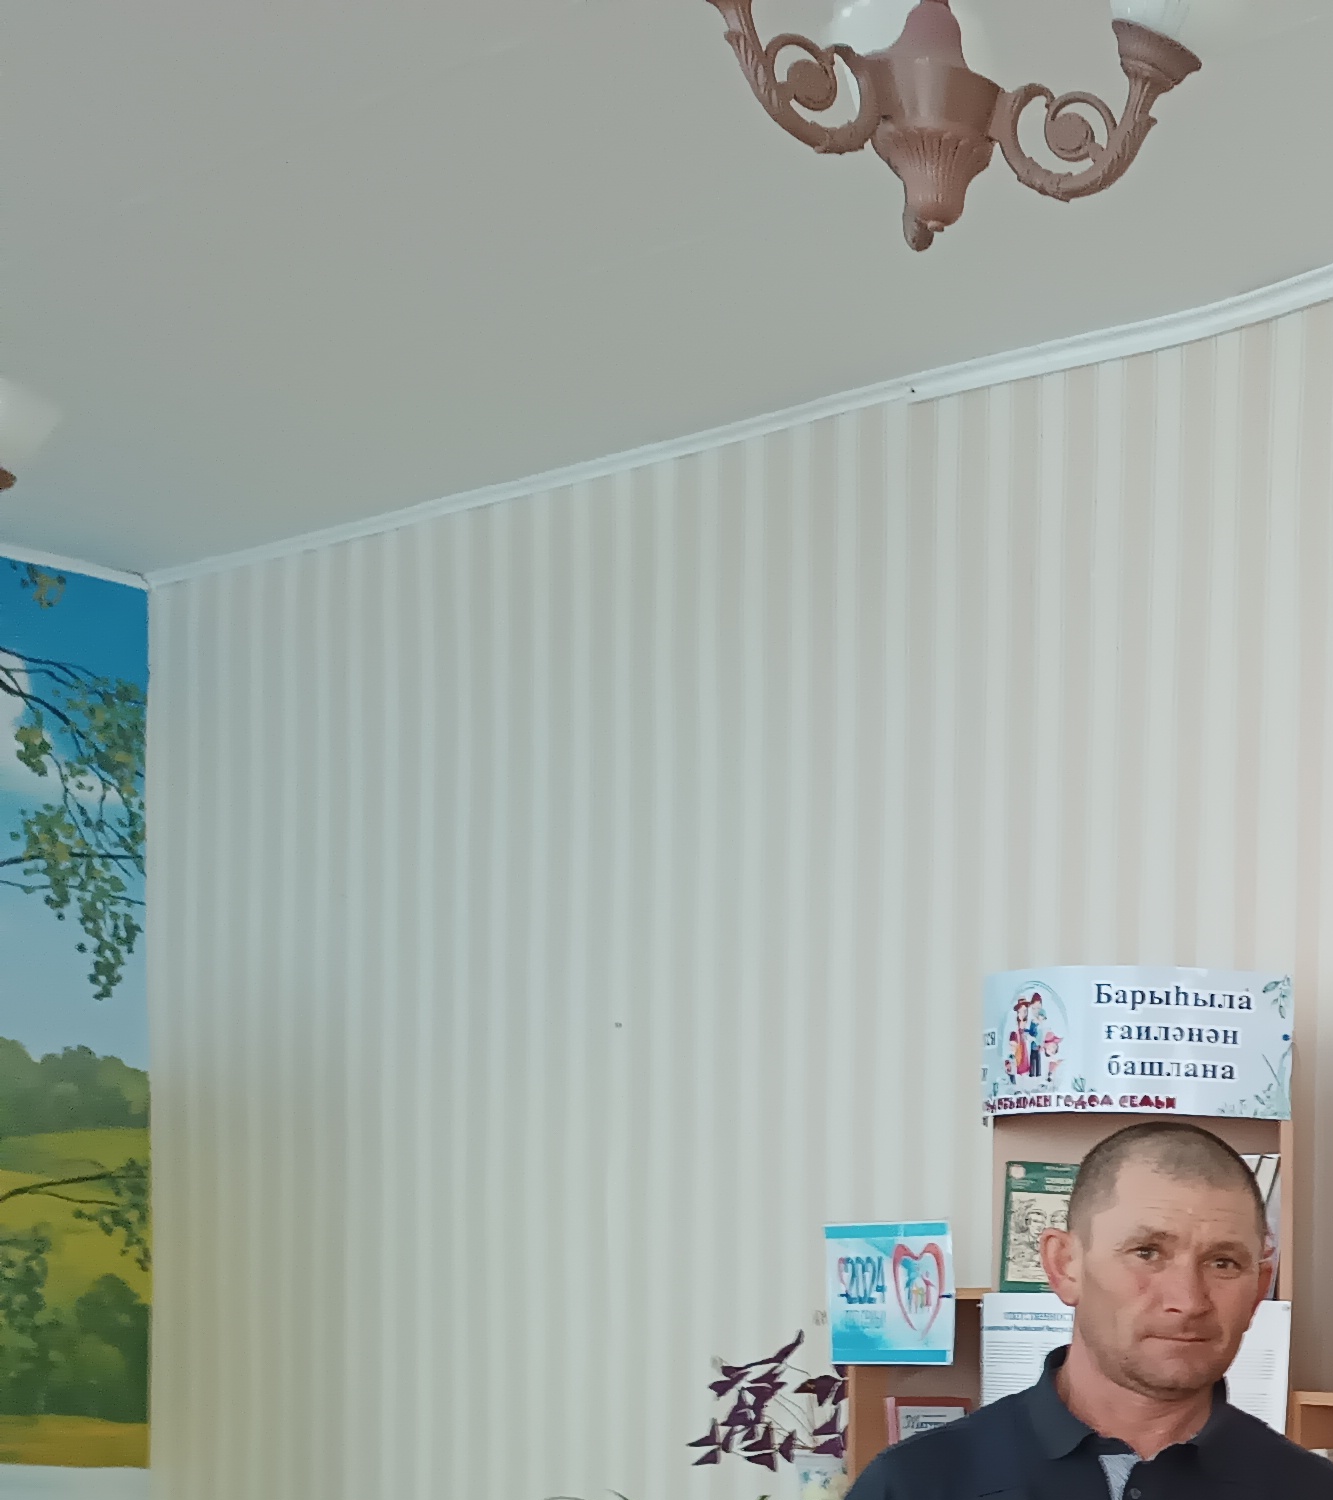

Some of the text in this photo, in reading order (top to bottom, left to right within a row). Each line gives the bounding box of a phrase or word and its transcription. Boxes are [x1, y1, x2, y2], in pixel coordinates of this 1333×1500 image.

[1107, 1055, 1236, 1081] башлана
[1118, 1095, 1177, 1110] СЕМЬИ
[838, 1256, 886, 1304] 2024
